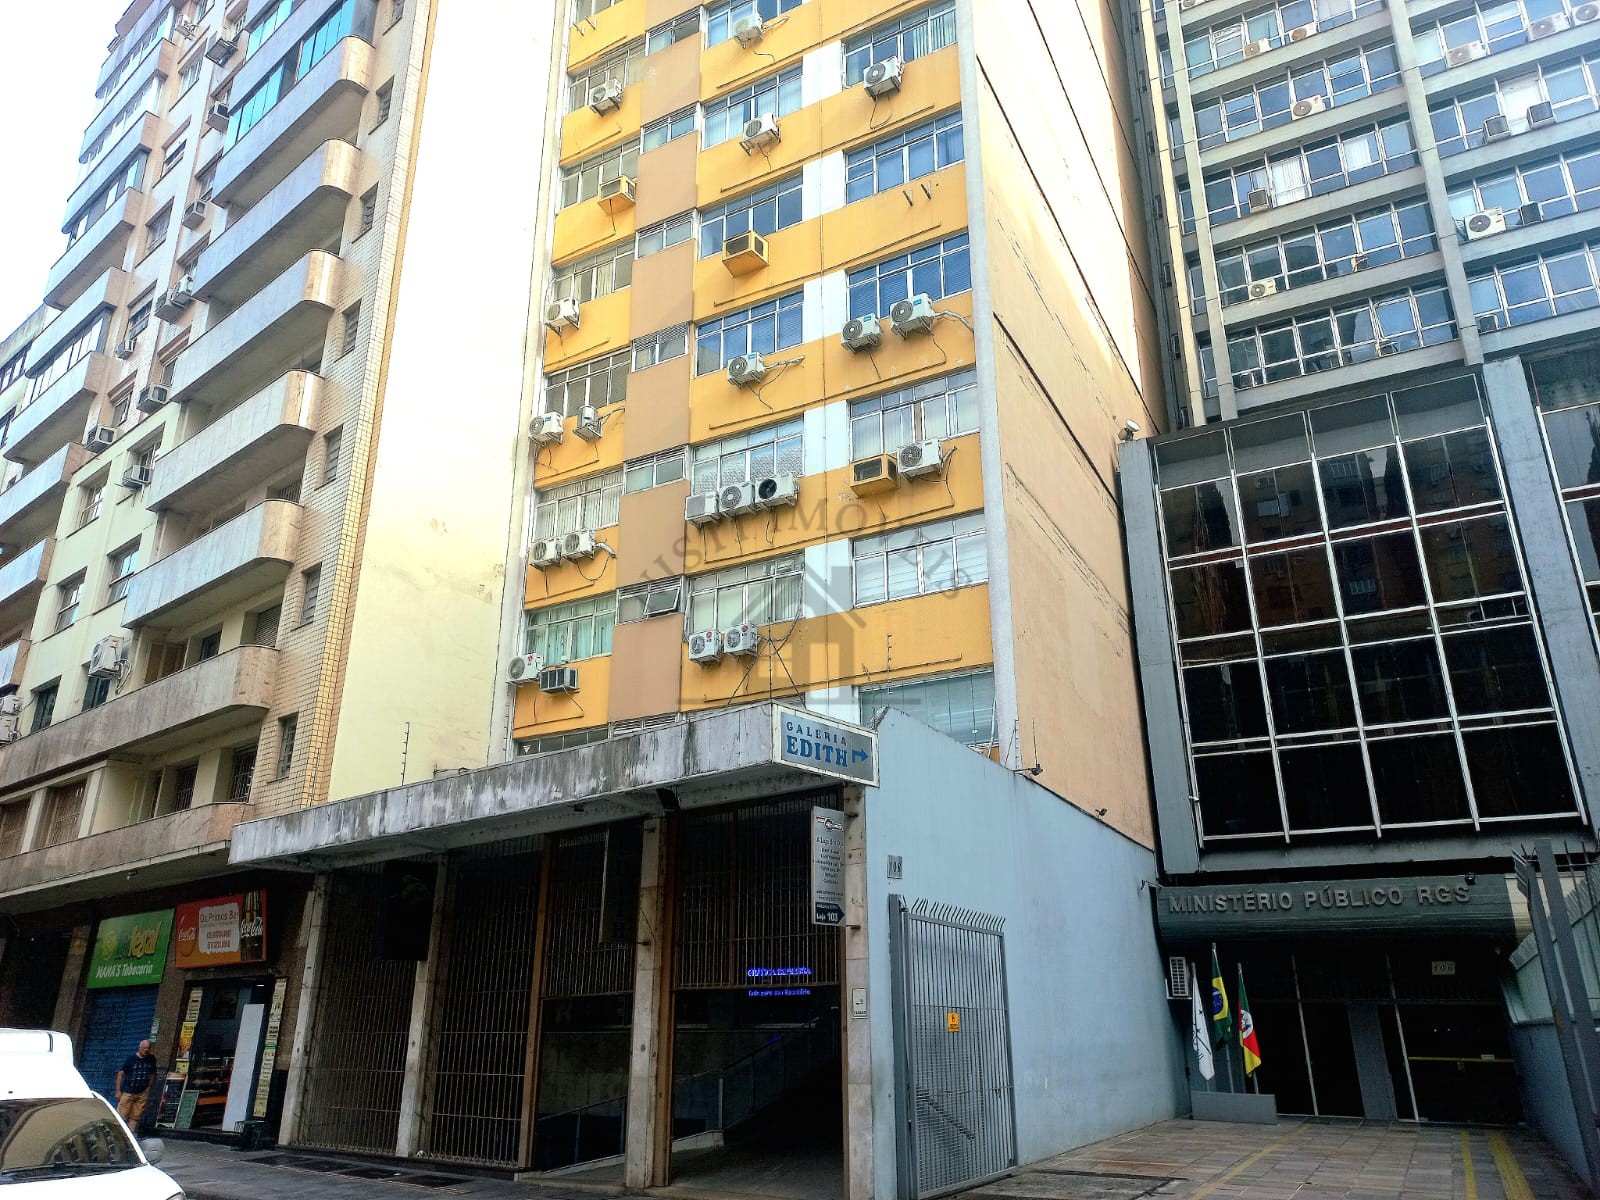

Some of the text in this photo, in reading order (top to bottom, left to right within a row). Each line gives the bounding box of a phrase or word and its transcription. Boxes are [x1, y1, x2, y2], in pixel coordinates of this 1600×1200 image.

[786, 721, 847, 746] GALERIA
[786, 734, 848, 767] EDITH
[1169, 884, 1472, 913] MINISTÉRIO PÚBLICO RGS
[827, 912, 839, 922] 103
